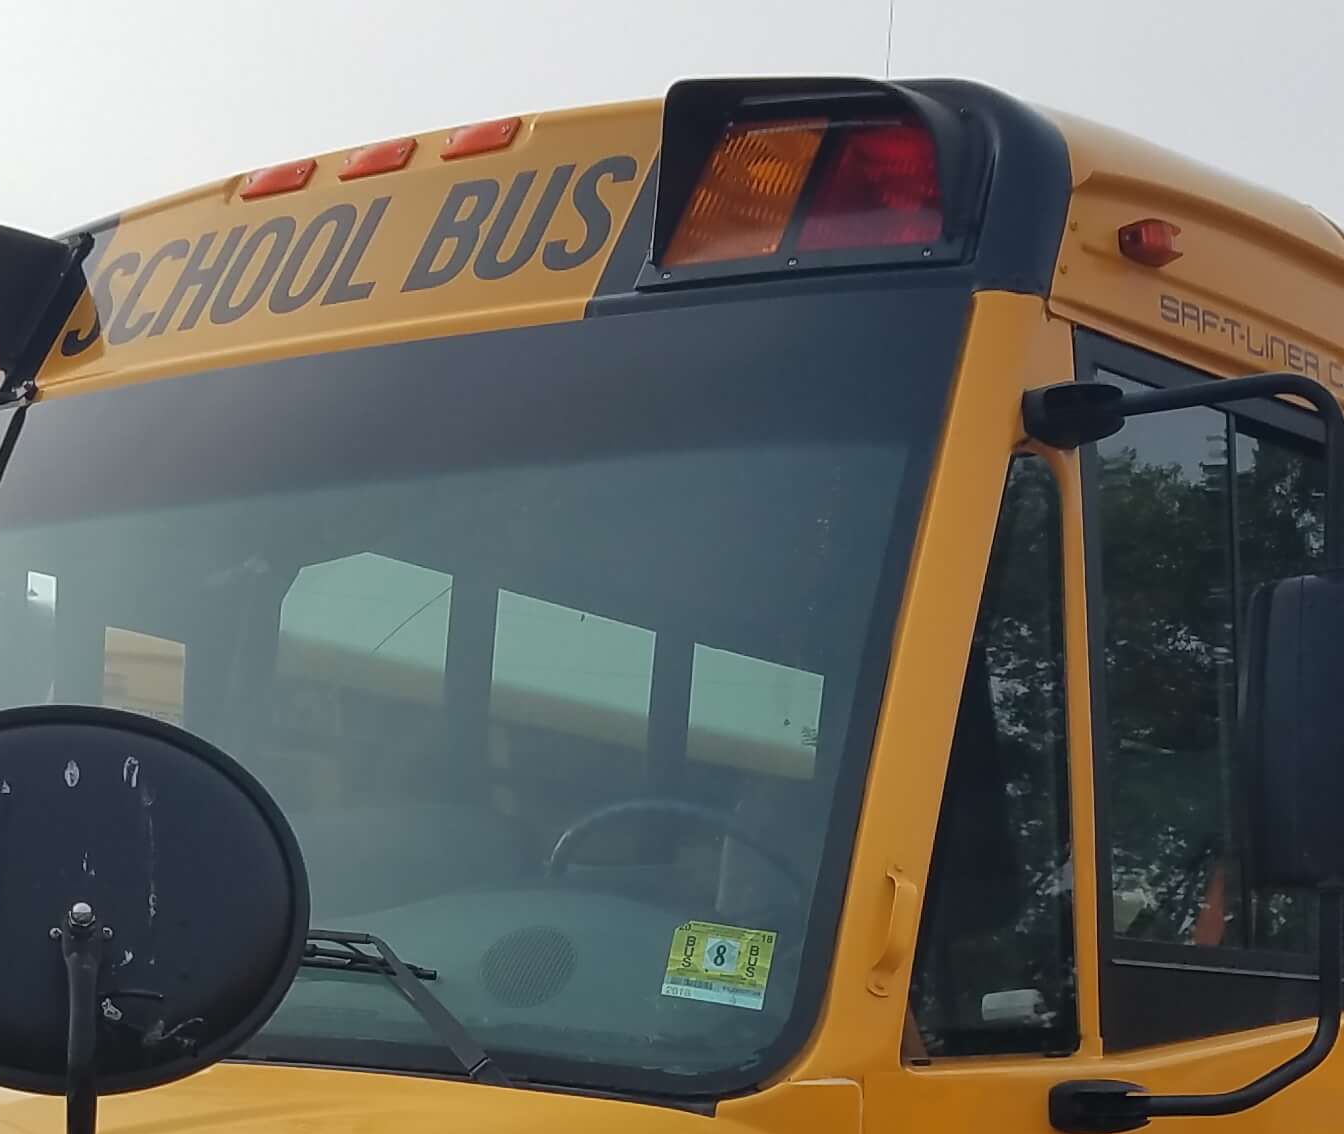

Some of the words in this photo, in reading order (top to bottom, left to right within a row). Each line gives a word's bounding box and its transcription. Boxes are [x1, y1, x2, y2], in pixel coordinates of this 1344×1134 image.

[60, 195, 391, 358] SCHOOL
[401, 155, 639, 292] BUS
[681, 936, 697, 968] BUS
[713, 944, 727, 967] 8
[745, 945, 760, 978] BUS
